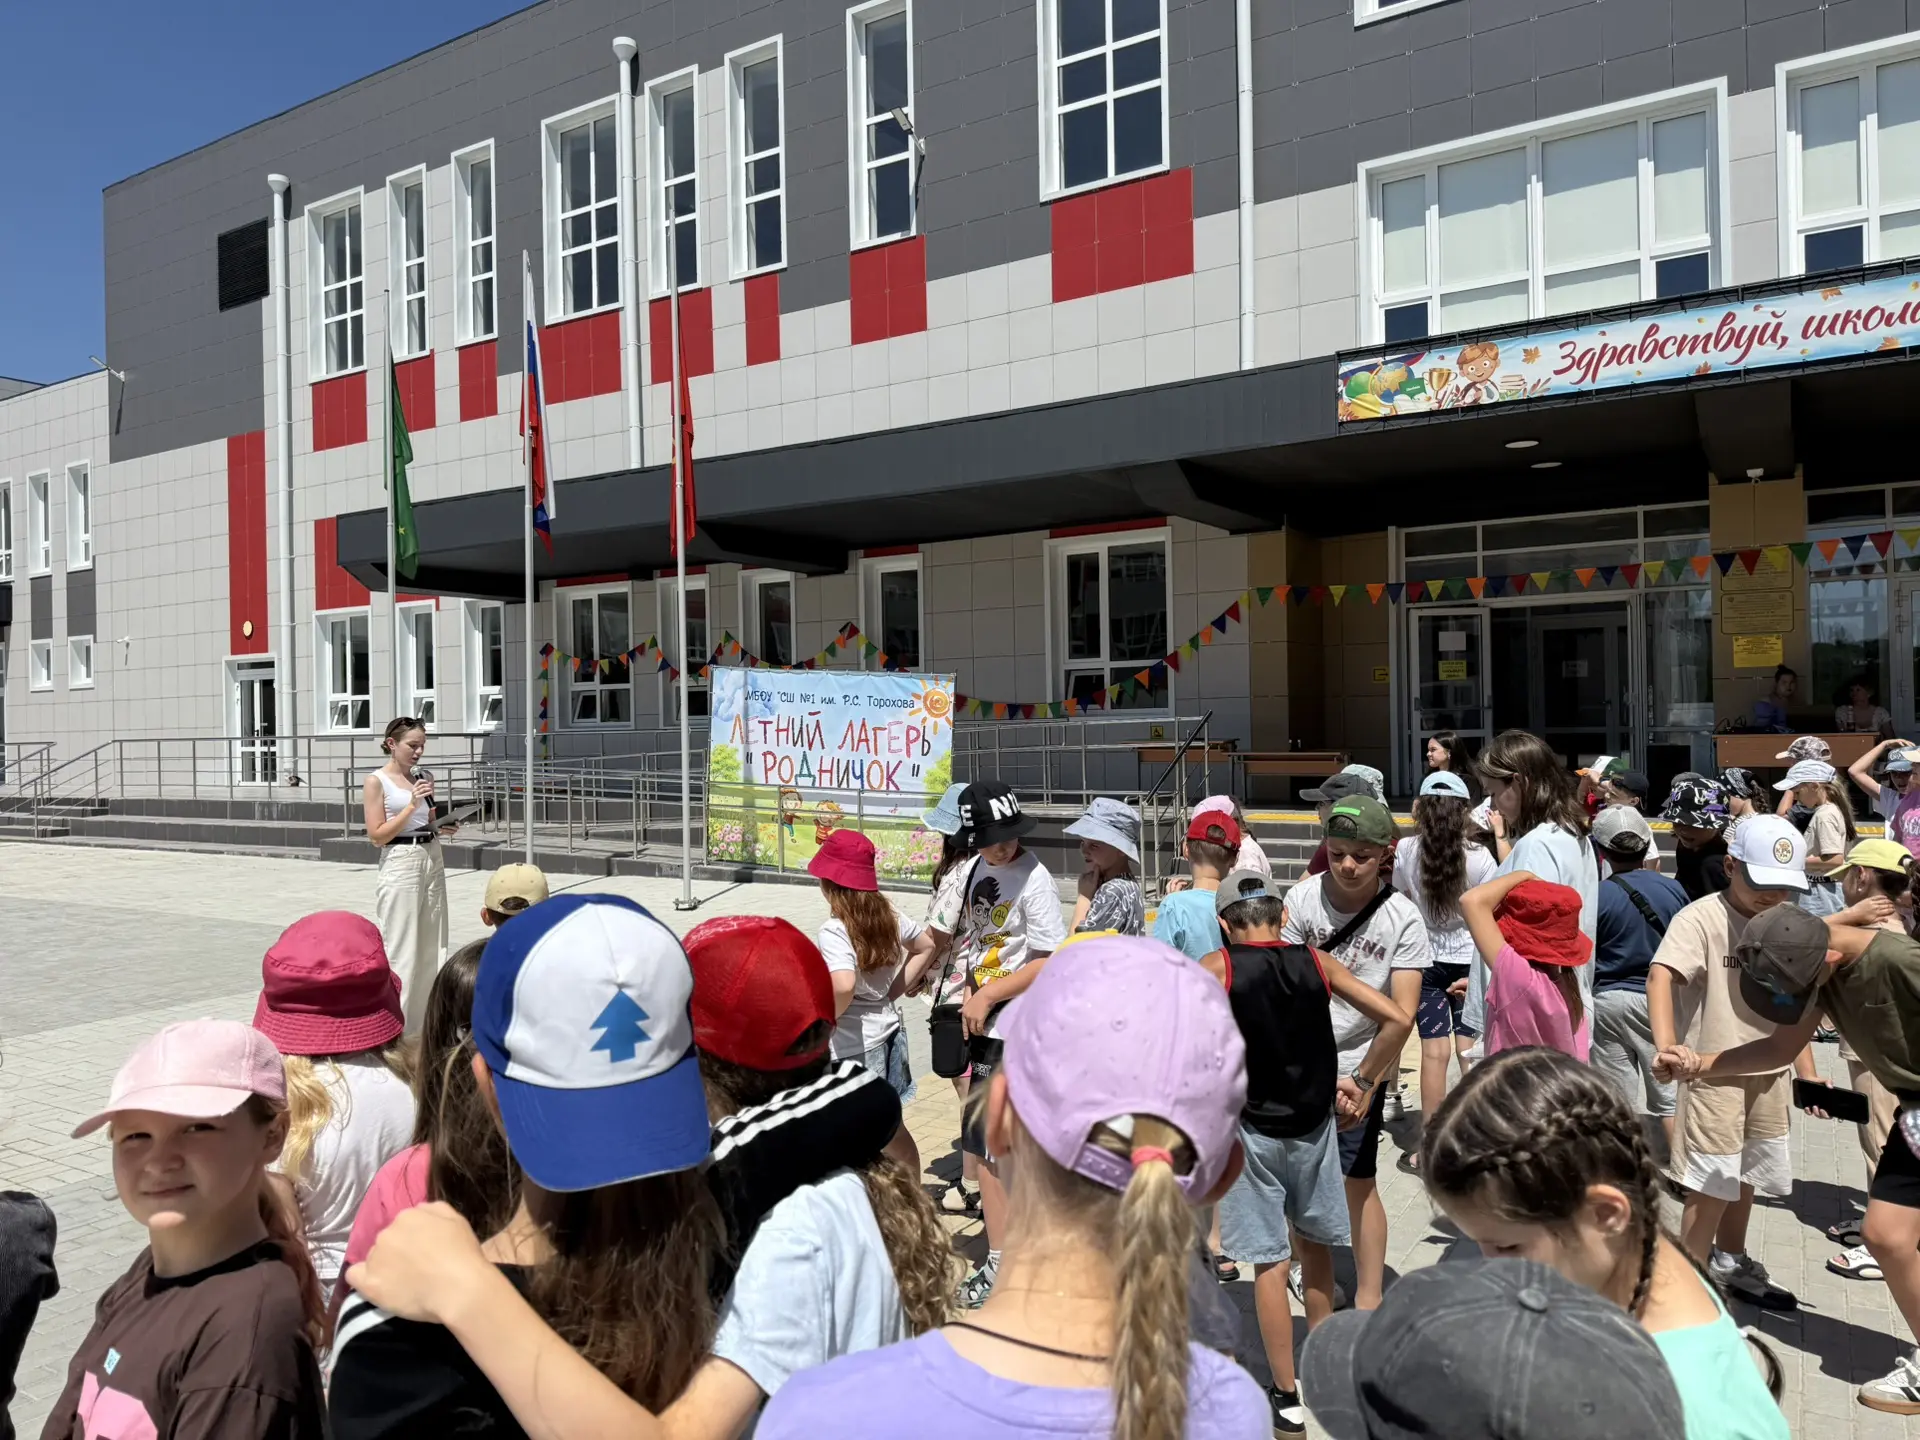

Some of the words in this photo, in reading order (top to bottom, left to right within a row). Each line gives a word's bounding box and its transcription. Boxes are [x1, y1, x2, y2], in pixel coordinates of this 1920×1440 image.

[1554, 310, 1788, 385] Здравствуй,
[745, 690, 773, 703] МБОУ
[800, 693, 816, 704] №1
[842, 694, 861, 706] Р.С.
[867, 695, 915, 710] Торохова
[730, 711, 825, 751] ЛЕТНИЙ
[837, 717, 931, 759] ЛАГЕРЬ
